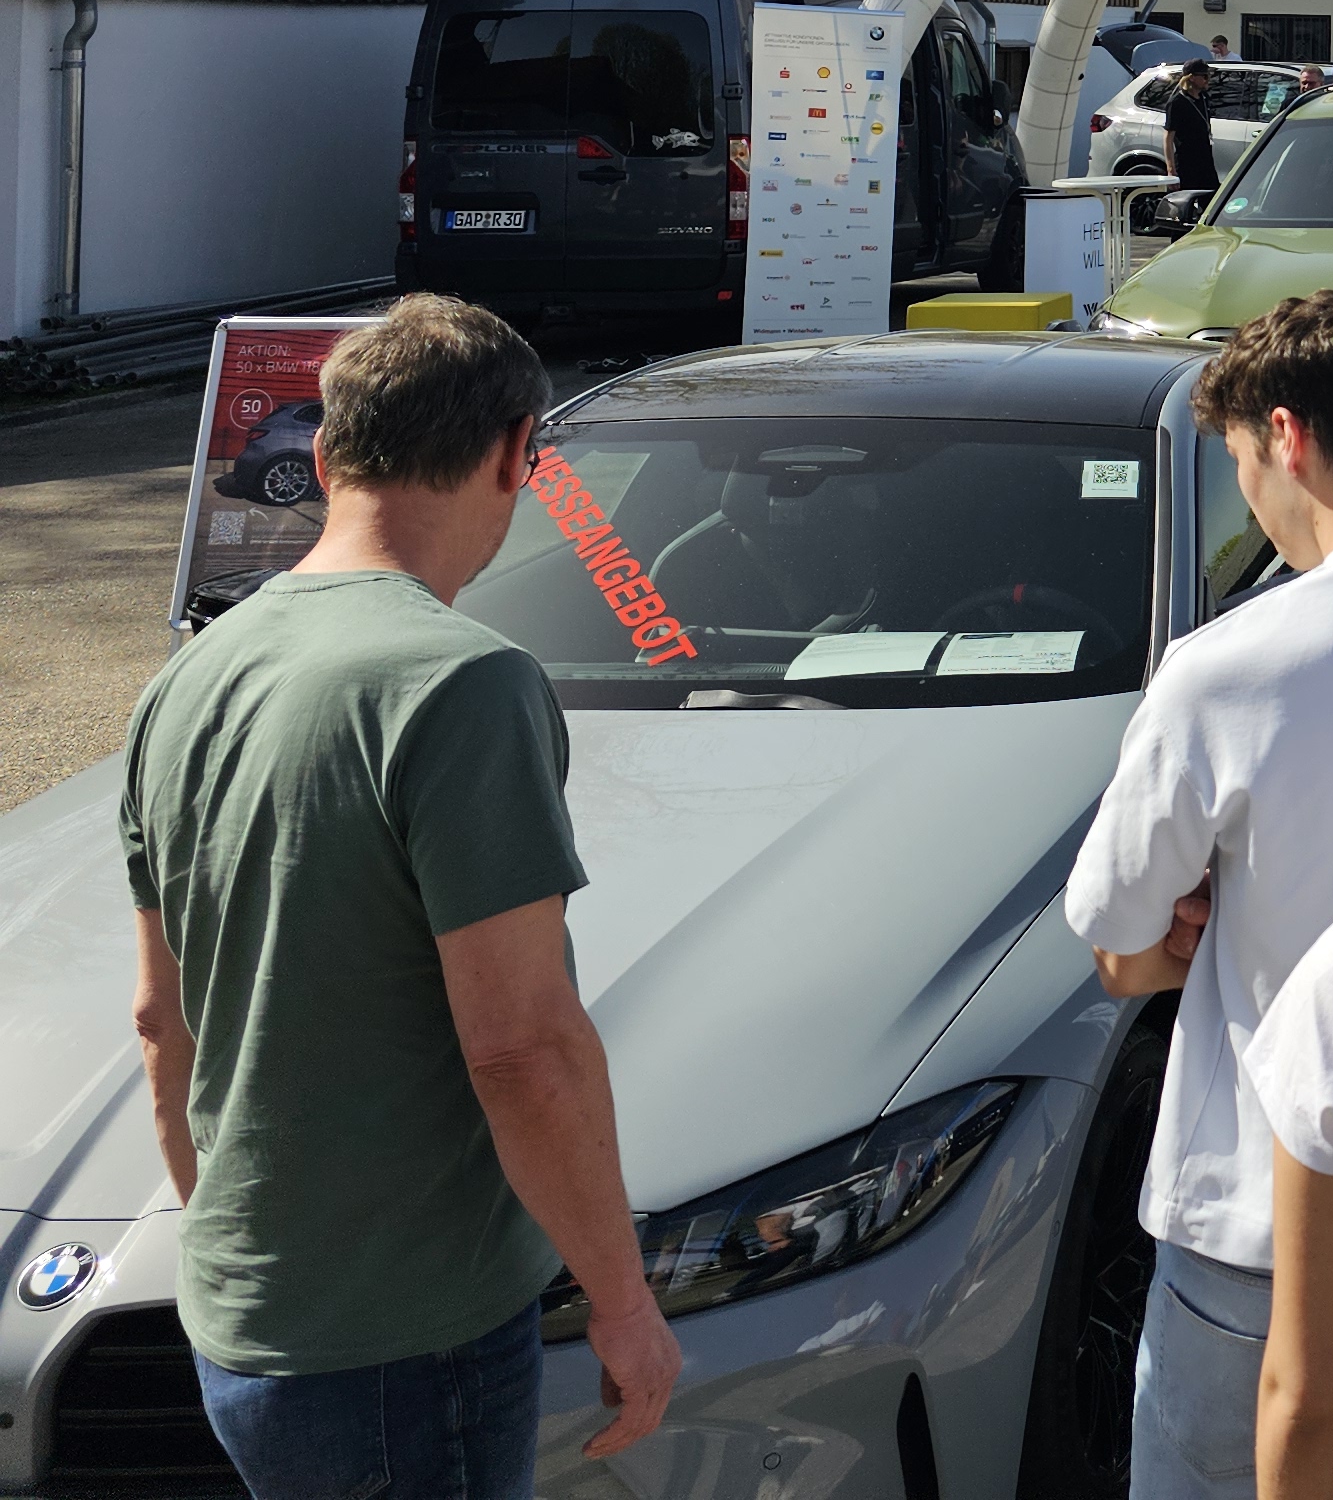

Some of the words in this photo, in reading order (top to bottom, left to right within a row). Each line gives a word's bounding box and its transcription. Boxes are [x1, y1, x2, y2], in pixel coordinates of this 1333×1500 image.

[454, 212, 482, 227] GAP
[1083, 252, 1104, 269] WIL
[238, 345, 291, 357] AKTION:
[235, 361, 253, 373] 50
[266, 362, 298, 373] BMW
[241, 399, 262, 413] 50
